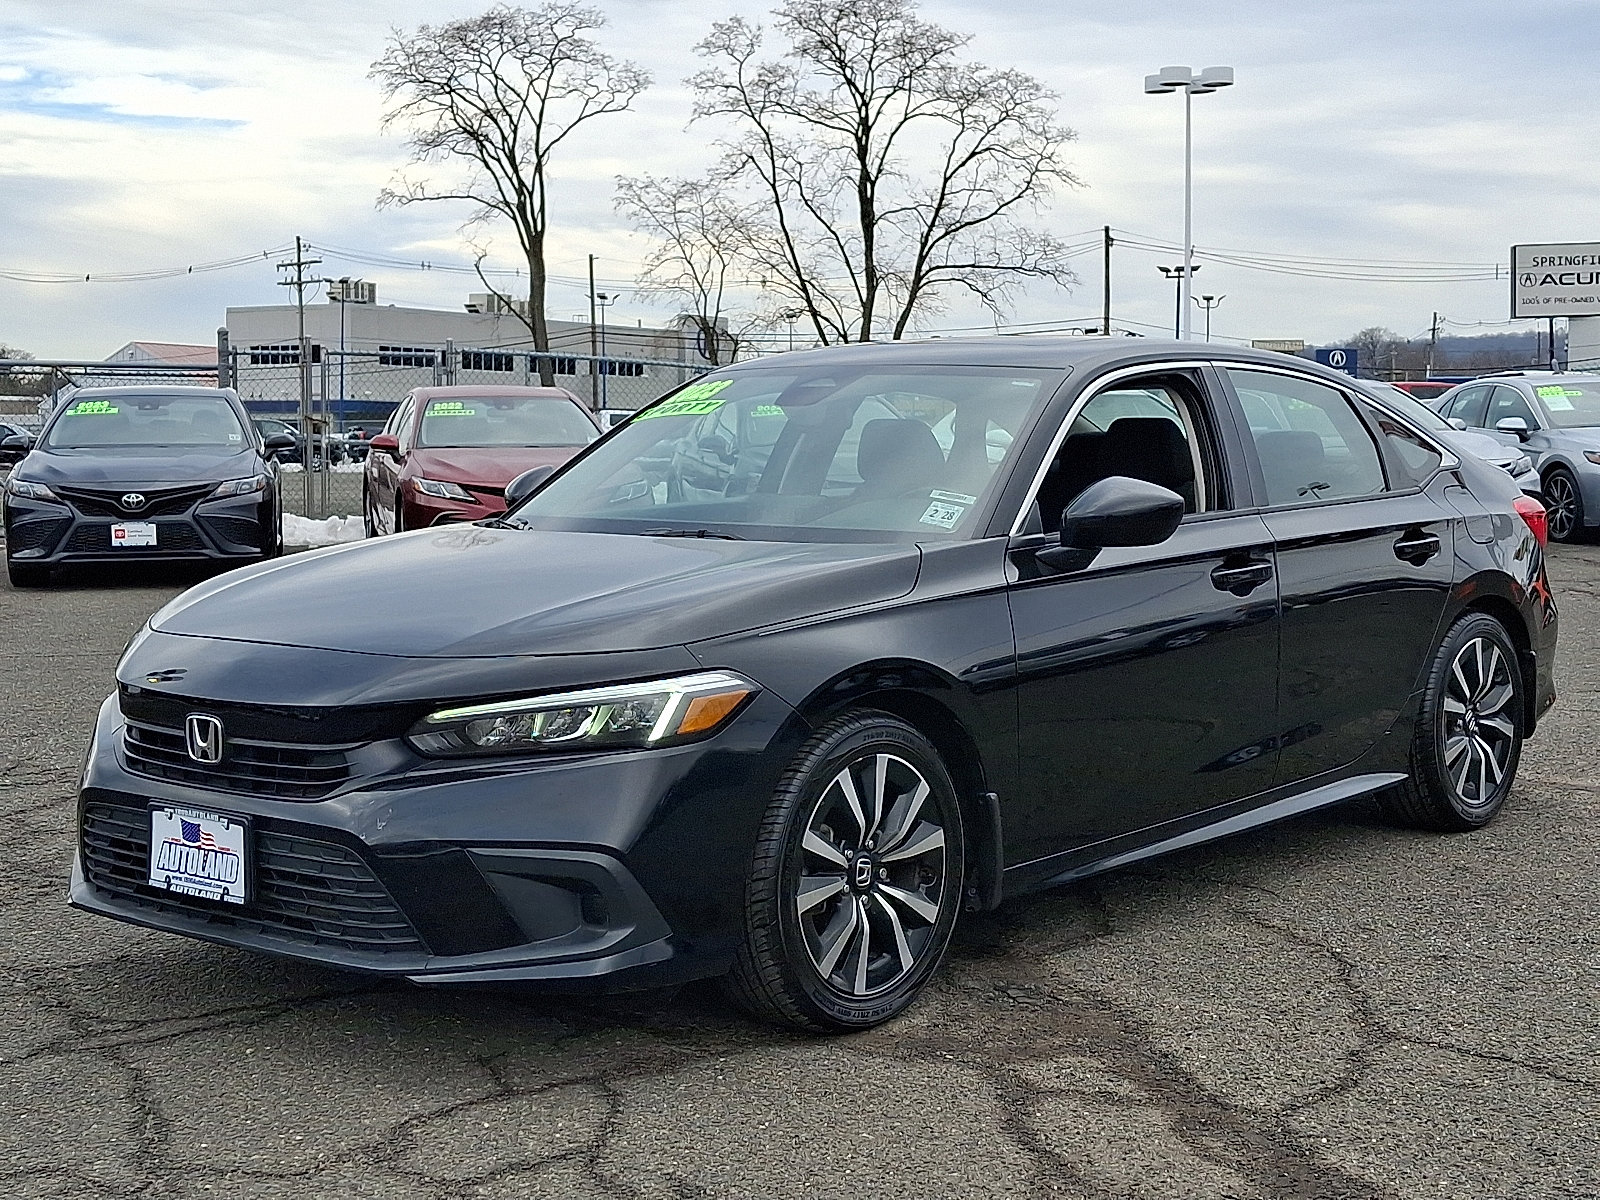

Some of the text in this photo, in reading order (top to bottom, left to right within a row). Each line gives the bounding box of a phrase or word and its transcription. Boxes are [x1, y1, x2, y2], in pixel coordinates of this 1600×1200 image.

[929, 509, 955, 520] 2 28
[157, 840, 240, 885] AUTOLAND
[169, 884, 222, 901] AUTOLAND
